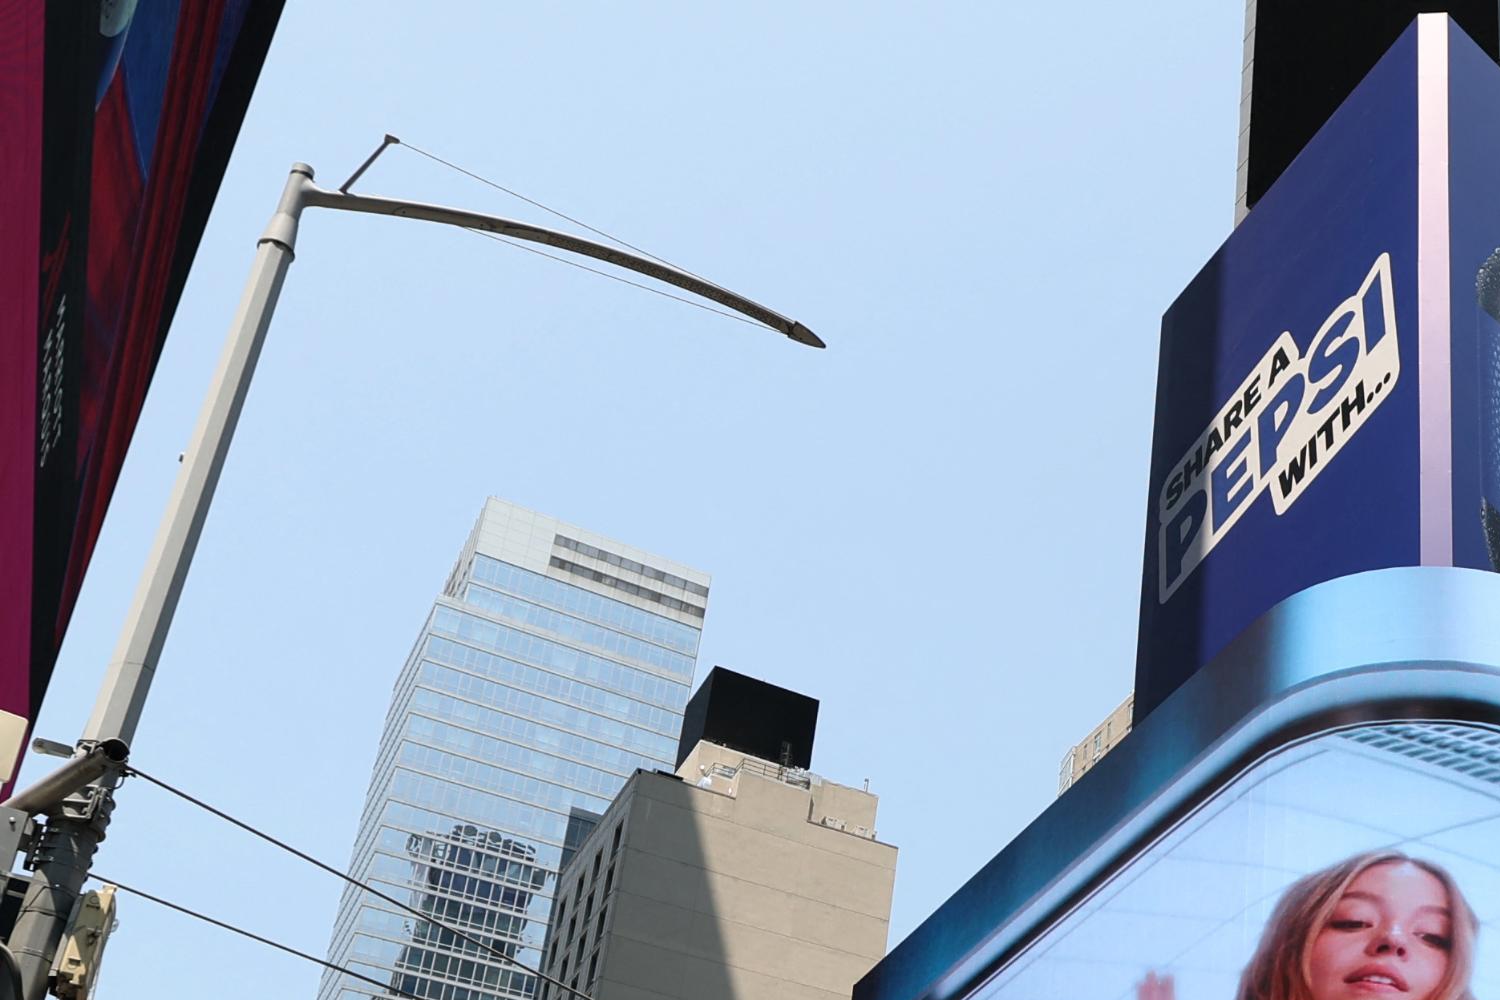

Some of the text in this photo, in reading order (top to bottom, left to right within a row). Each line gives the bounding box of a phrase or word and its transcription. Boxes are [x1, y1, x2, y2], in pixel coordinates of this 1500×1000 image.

[1165, 268, 1387, 591] PEPSI
[1166, 345, 1291, 511] SHARE A
[1277, 371, 1391, 499] WITH...
